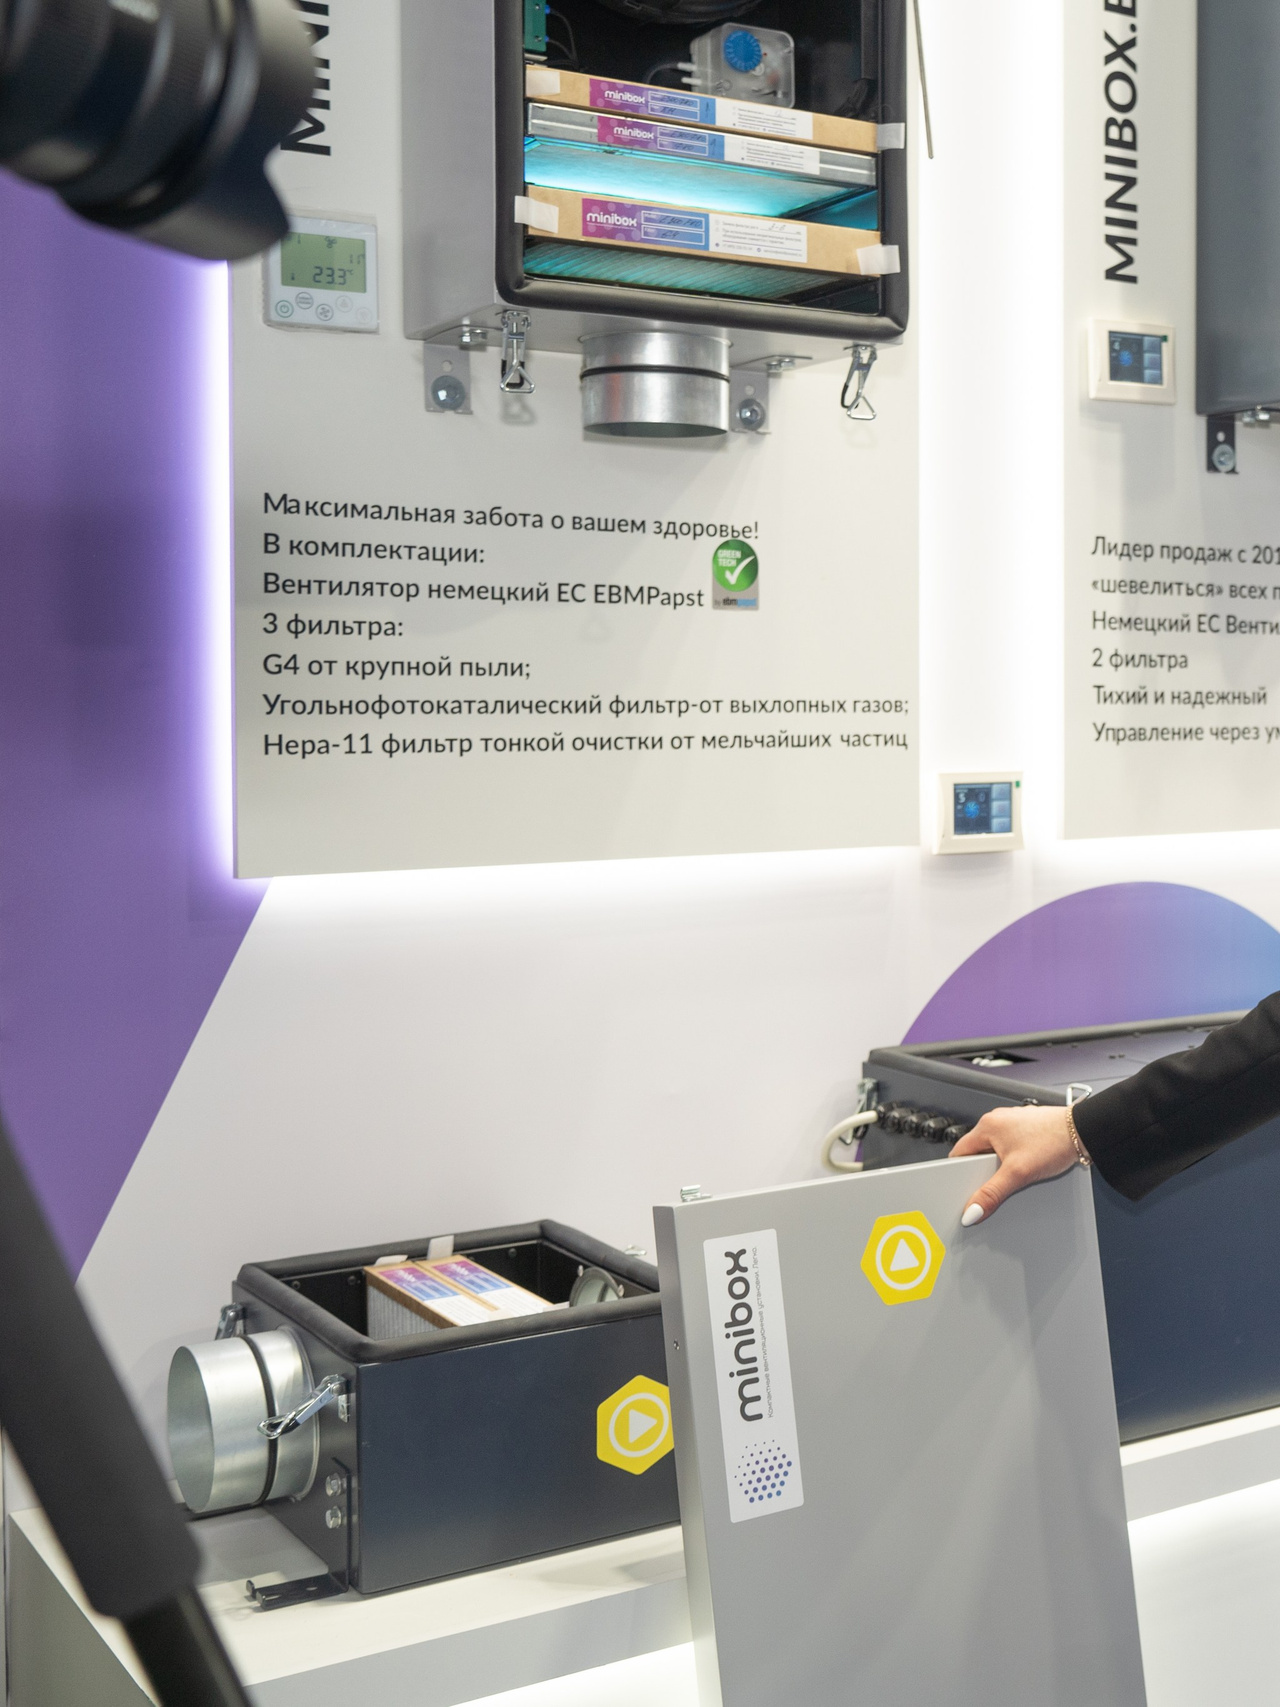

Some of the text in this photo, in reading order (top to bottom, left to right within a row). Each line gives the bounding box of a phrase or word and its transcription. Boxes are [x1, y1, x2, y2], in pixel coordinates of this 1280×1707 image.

[605, 89, 646, 105] minibox
[613, 125, 654, 140] minibox
[586, 211, 637, 227] minibox
[264, 492, 759, 540] Максимальная забота о вашем здоровье!
[264, 532, 485, 566] В комплектации:
[1091, 536, 1154, 562] Лидер
[1160, 542, 1233, 565] продаж
[1237, 548, 1247, 564] с
[264, 572, 420, 602] Вентилятор
[428, 581, 549, 605] немецкий
[594, 584, 705, 610] EBMPapst
[1092, 577, 1223, 599] «шевелиться»
[1229, 583, 1267, 599] всех
[263, 612, 404, 640] 3 фильтра:
[1092, 611, 1191, 636] Немецкий
[263, 653, 531, 680] G4 от крупной пыли;
[1092, 648, 1188, 671] 2 фильтра
[263, 693, 909, 719] Угольнофотокаталический фильтр-от выхлопных газов;
[1093, 685, 1267, 709] Тихий и надежный
[382, 732, 472, 758] фильтр
[480, 732, 564, 752] тонкой
[572, 734, 664, 752] очистки
[670, 735, 695, 751] от
[701, 730, 831, 749] мельчайших
[840, 732, 908, 749] частиц
[1092, 721, 1204, 746] Управление
[1210, 723, 1260, 745] через
[724, 1247, 764, 1421] minibox
[758, 1310, 770, 1371] вентиляционные
[766, 1372, 775, 1418] Компактные
